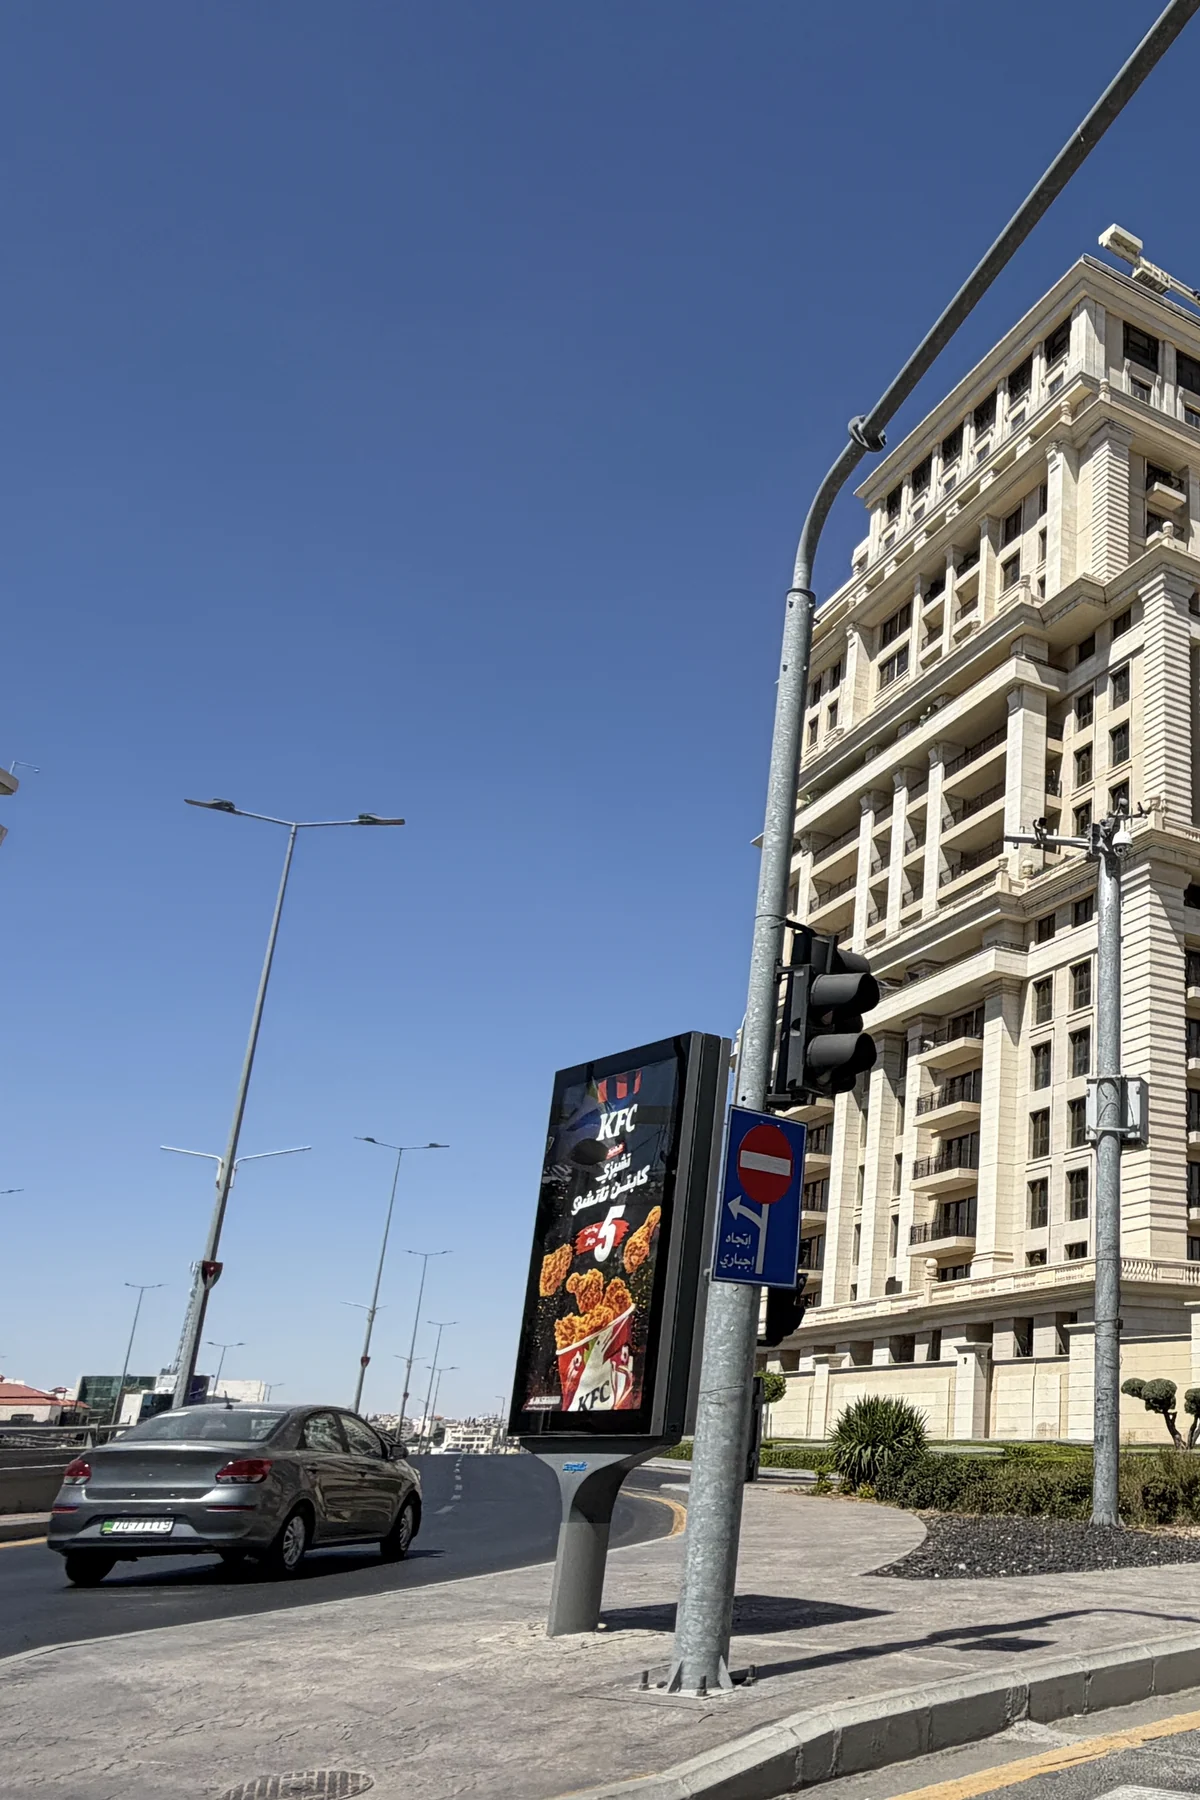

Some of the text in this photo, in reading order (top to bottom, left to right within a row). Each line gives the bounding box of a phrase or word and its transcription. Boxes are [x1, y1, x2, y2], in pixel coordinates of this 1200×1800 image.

[596, 1104, 638, 1141] KFC
[594, 1204, 626, 1262] 5
[578, 1380, 610, 1411] KFC
